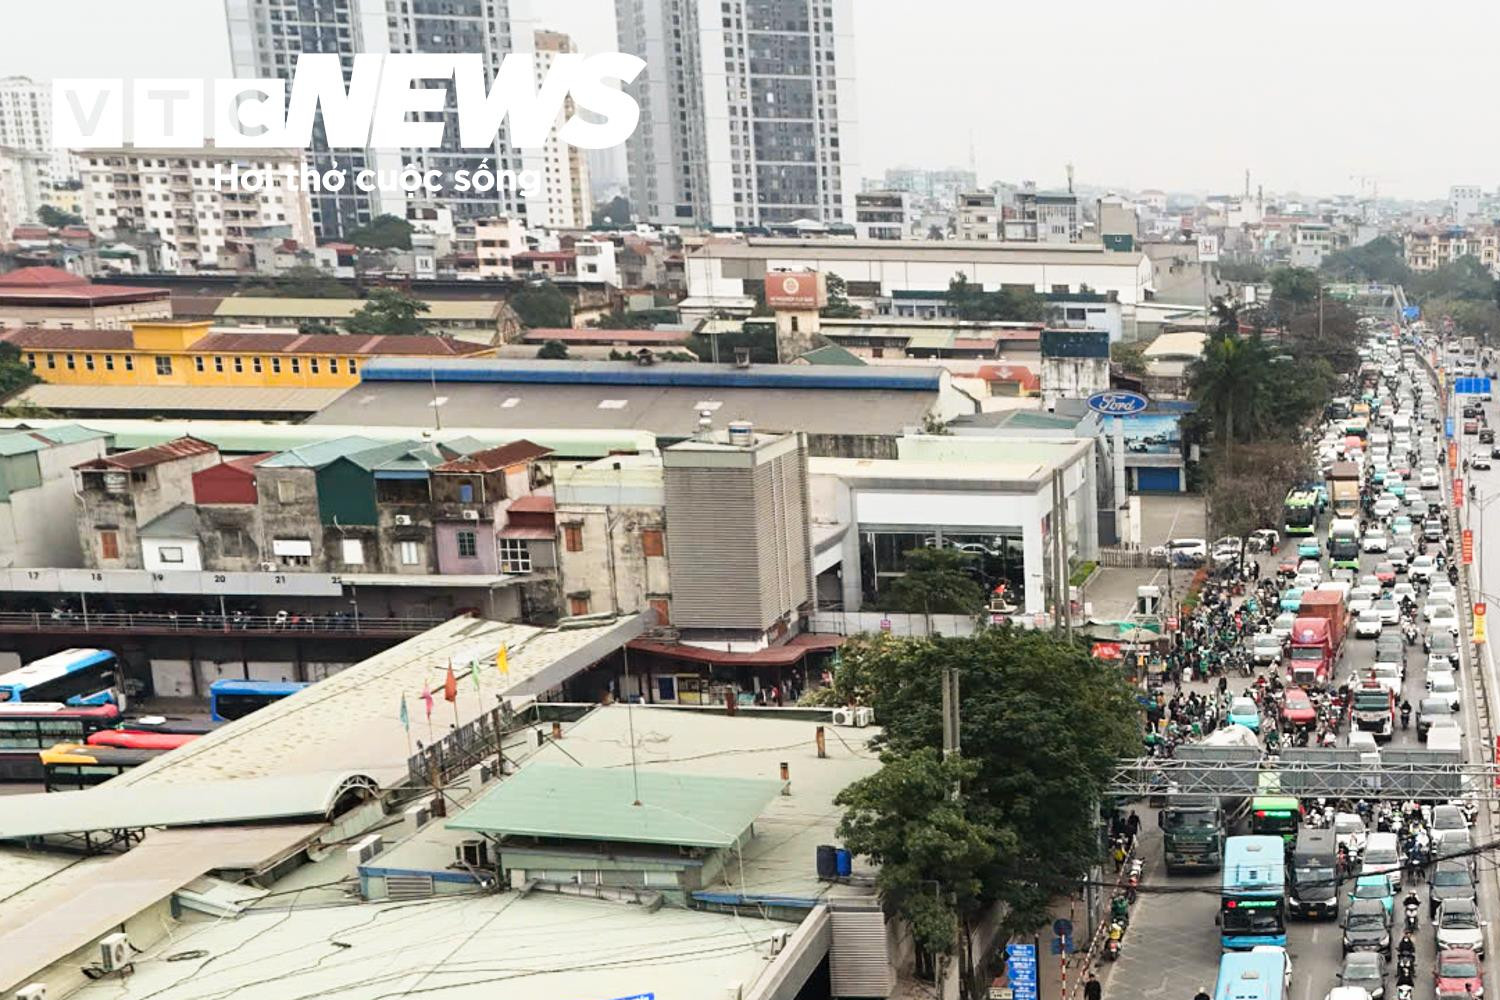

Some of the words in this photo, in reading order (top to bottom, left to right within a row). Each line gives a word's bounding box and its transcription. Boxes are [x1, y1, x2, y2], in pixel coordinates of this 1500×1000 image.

[1098, 395, 1136, 411] Ford
[28, 571, 39, 580] 17
[214, 575, 226, 583] 20
[275, 576, 286, 584] 21
